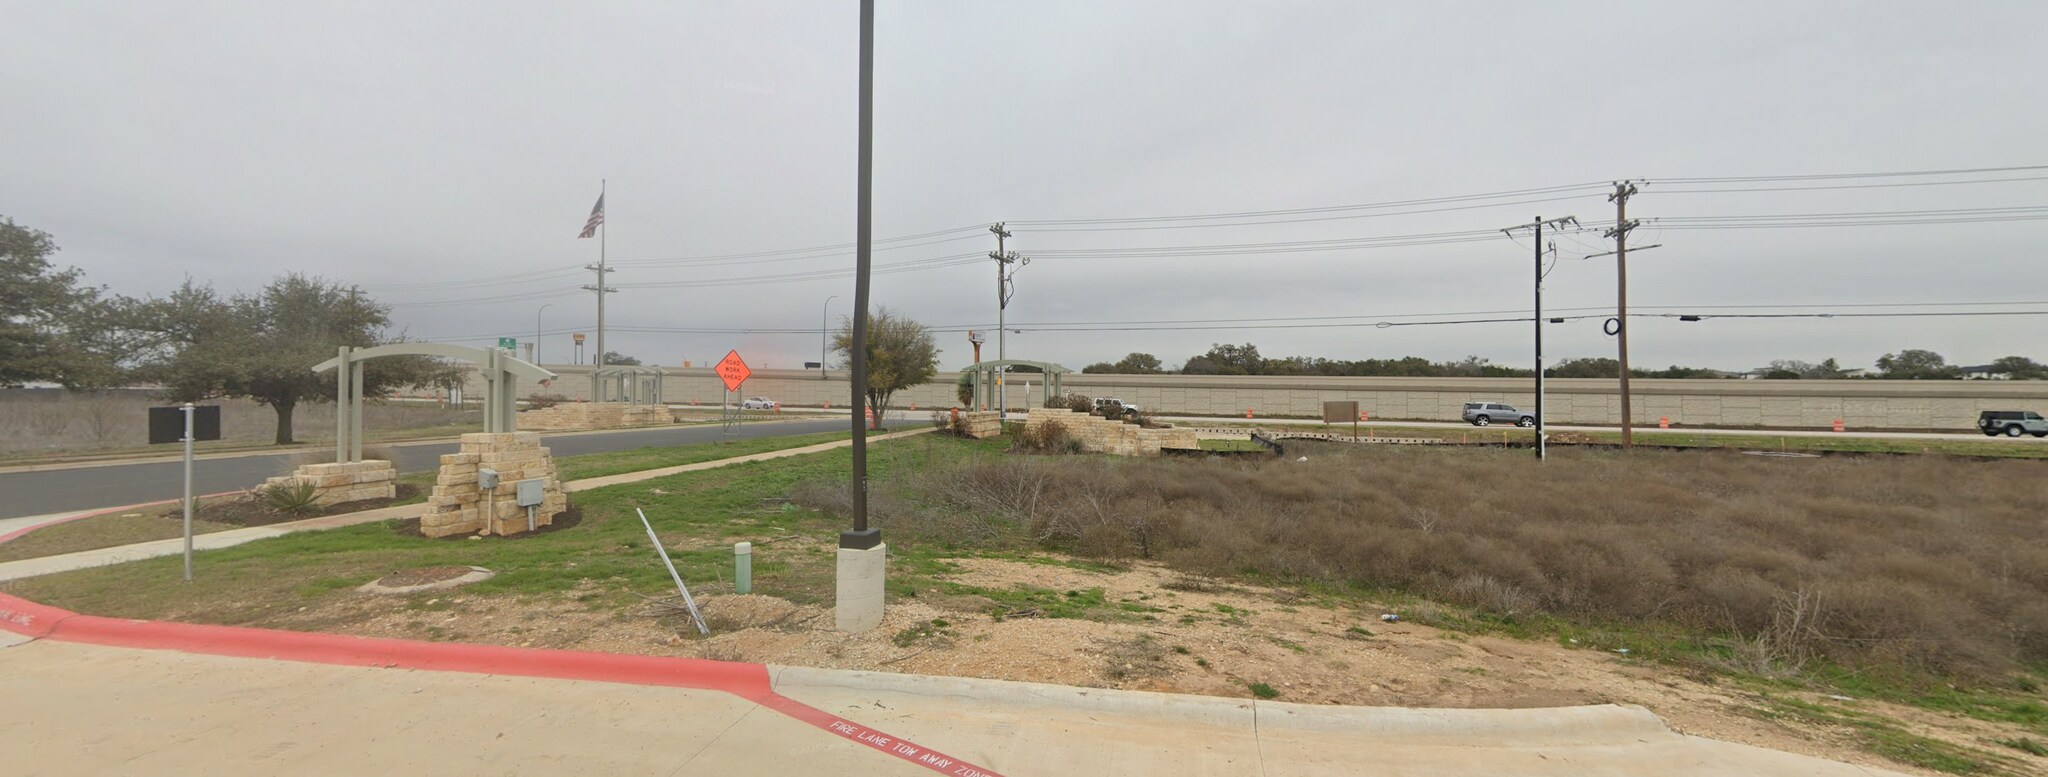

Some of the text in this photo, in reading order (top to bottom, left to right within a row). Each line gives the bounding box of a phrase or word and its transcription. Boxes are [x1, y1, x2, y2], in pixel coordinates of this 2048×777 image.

[725, 359, 741, 367] ROAD
[723, 373, 742, 381] AHEAD
[830, 720, 858, 735] FIRE
[857, 731, 891, 747] LANE
[892, 742, 919, 757] TOW
[919, 753, 952, 769] AWAY
